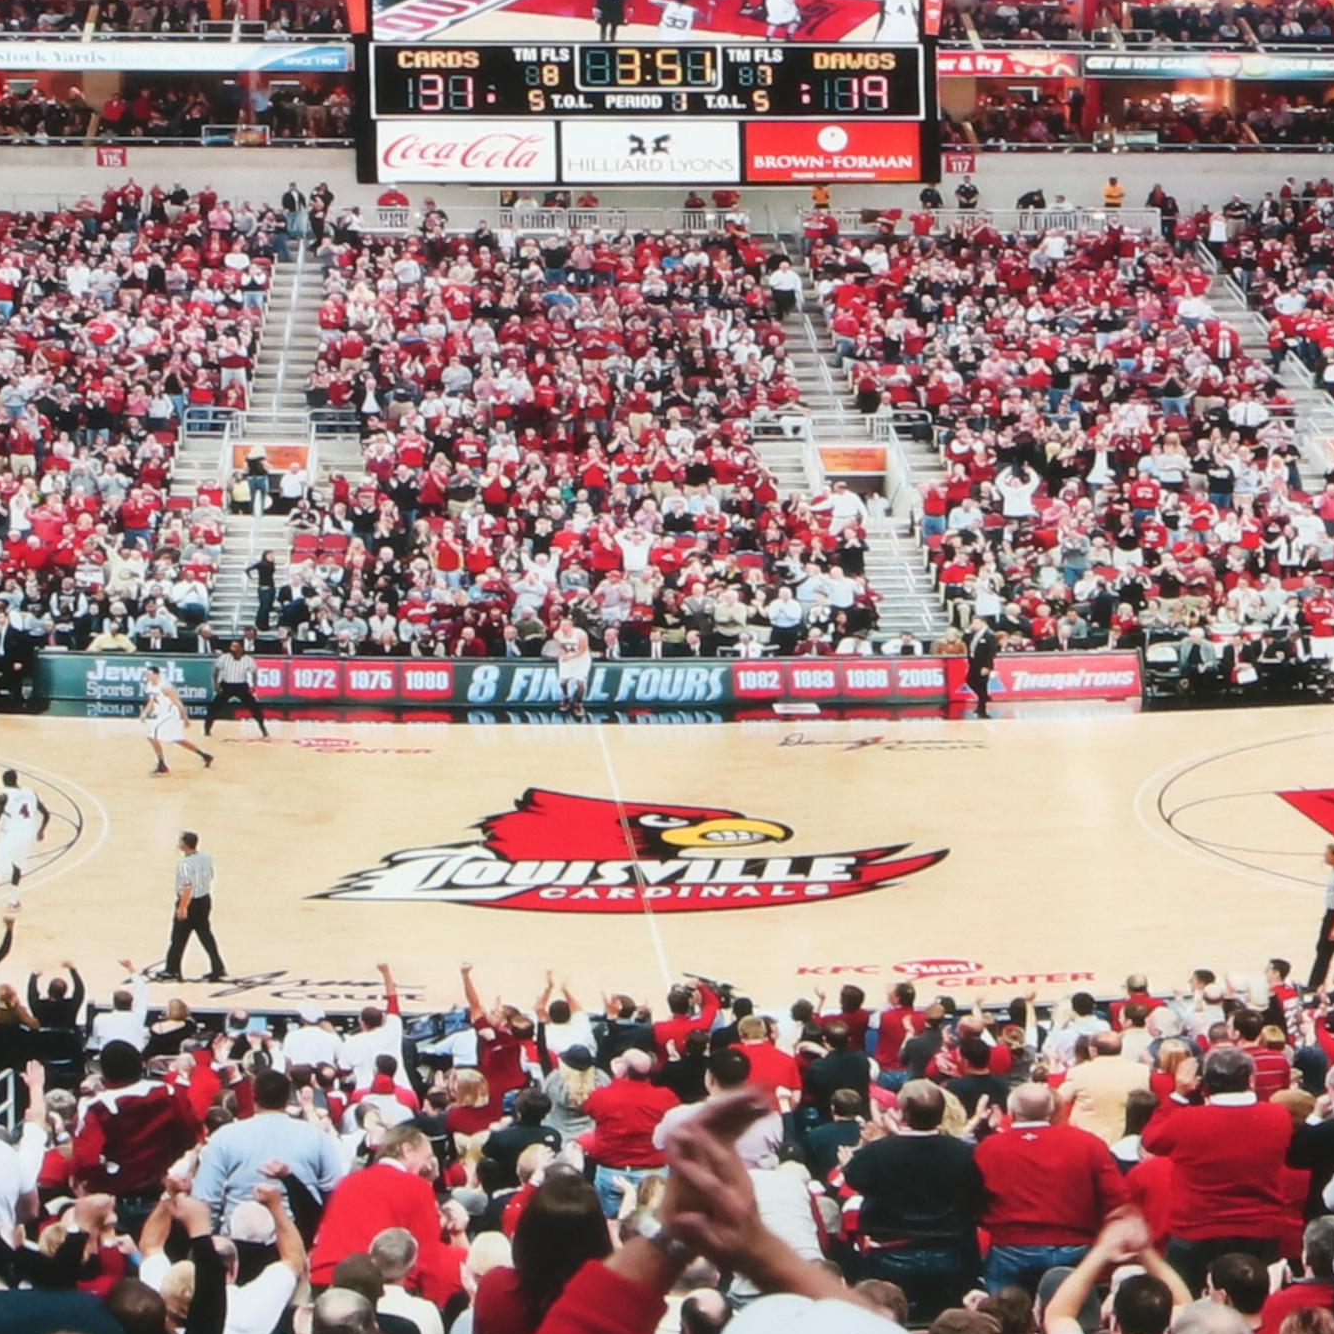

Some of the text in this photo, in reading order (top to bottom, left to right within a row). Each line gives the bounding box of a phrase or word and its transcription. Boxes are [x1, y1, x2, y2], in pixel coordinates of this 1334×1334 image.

[52, 50, 105, 64] Yards
[397, 50, 480, 69] CARDS
[513, 48, 570, 62] TM FLS
[726, 48, 784, 63] TM FLS
[813, 52, 896, 70] DAWGS
[976, 55, 1003, 73] Fry
[551, 94, 593, 109] T.O.L.
[605, 94, 663, 109] PERIOD
[704, 94, 746, 109] T.O.L.
[382, 132, 547, 170] Coca-Cola
[101, 153, 123, 167] 115
[567, 157, 734, 173] HILLIARD LYONS
[753, 154, 913, 169] BROWN-FORMAN
[951, 160, 971, 173] 117
[293, 668, 337, 689] 1972
[349, 669, 393, 691] 1975
[405, 669, 449, 691] 1980
[468, 665, 728, 703] 8 FINL FOURS
[737, 669, 780, 690] 1982
[899, 668, 945, 689] 2005
[86, 681, 135, 701] Sports
[19, 803, 30, 819] 4
[332, 847, 857, 901] LOUISVILLE
[538, 883, 830, 900] CARDINALS
[796, 960, 977, 975] KFC Yum!
[935, 971, 1096, 988] CENTER
